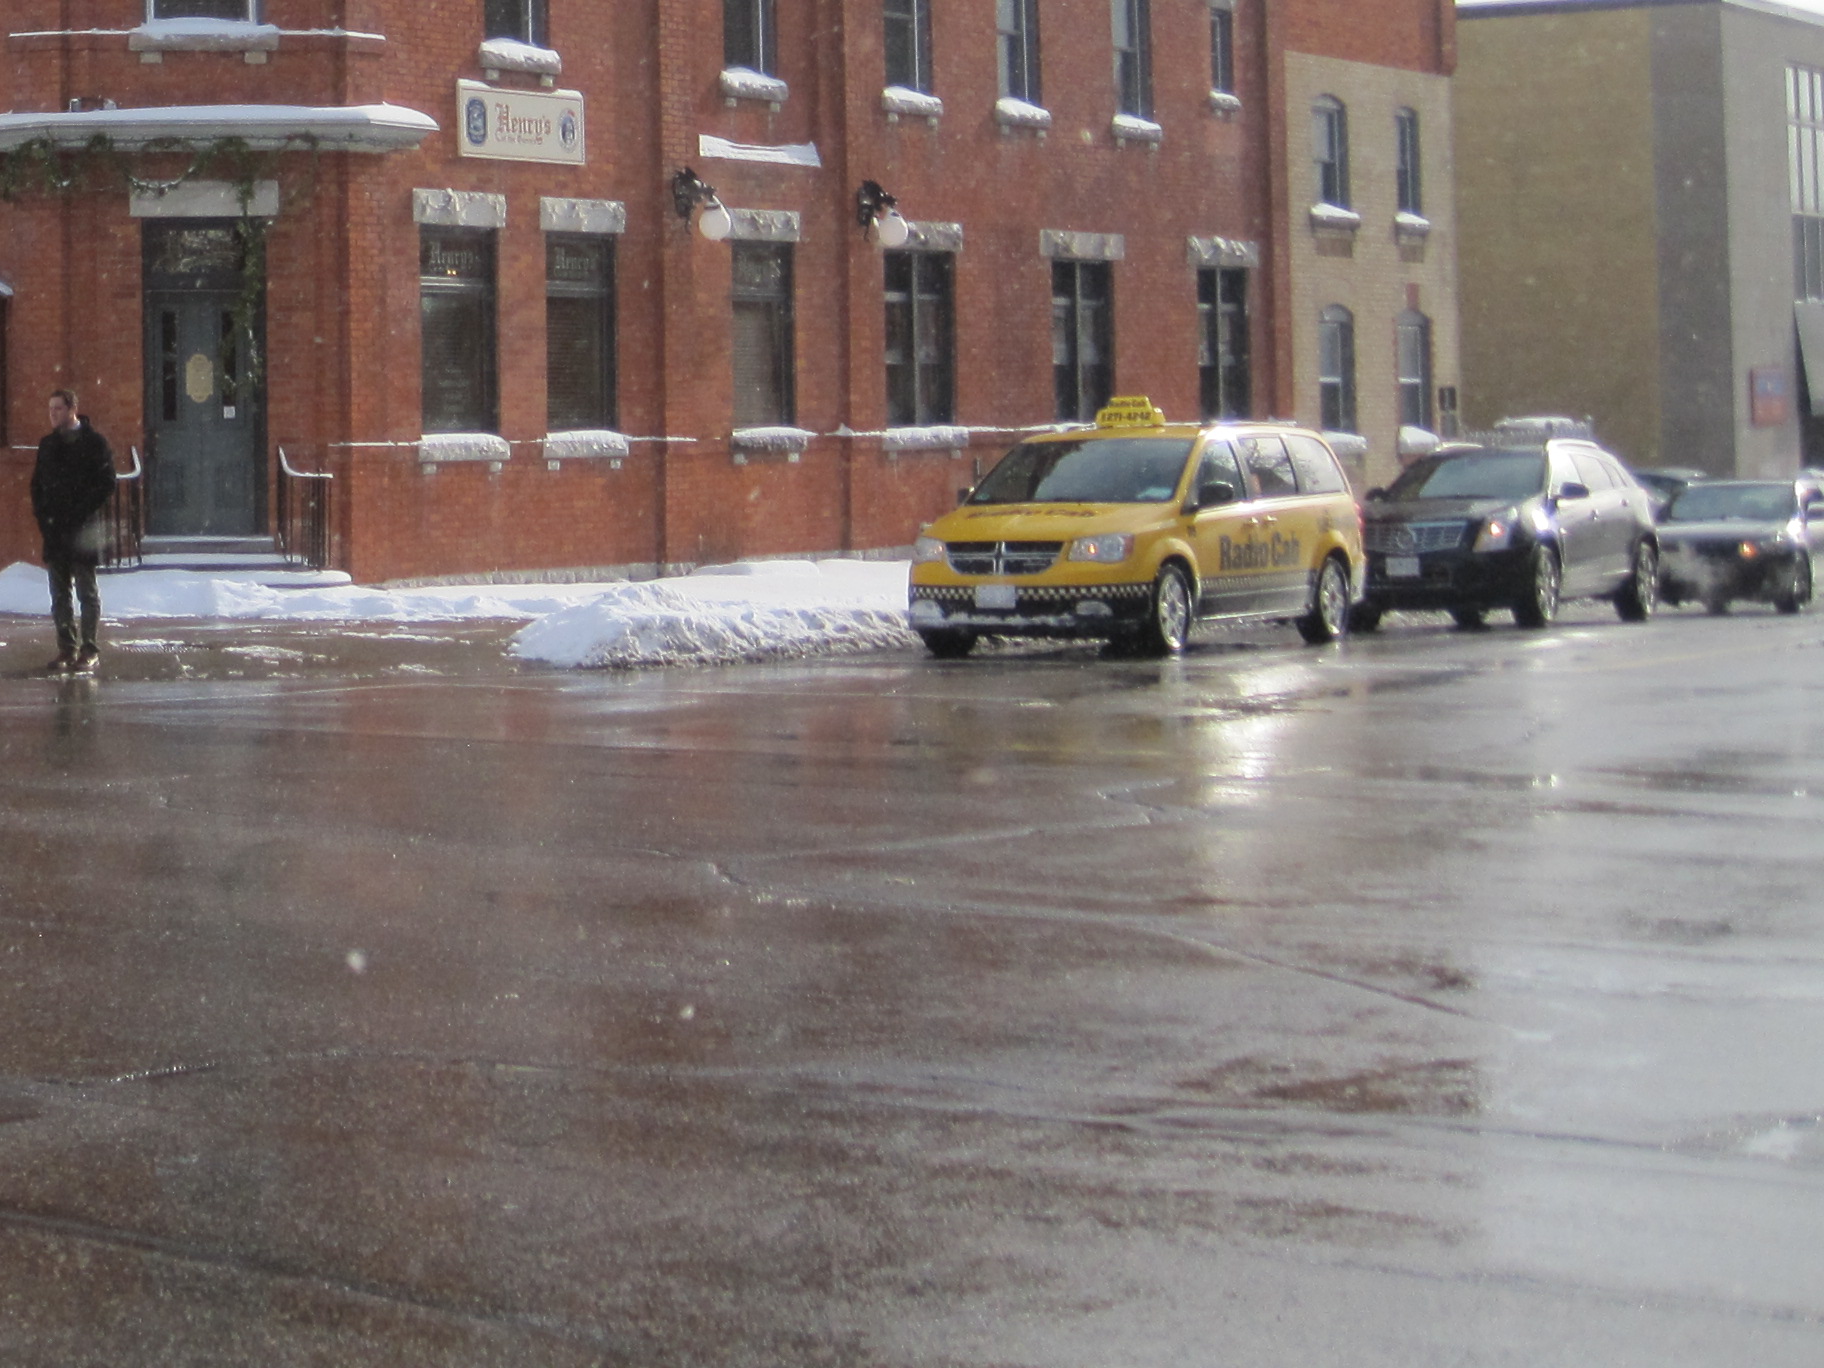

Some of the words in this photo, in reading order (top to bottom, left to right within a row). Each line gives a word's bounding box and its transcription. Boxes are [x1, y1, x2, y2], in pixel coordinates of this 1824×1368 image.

[495, 102, 551, 136] Henry's
[1219, 534, 1269, 571] Radio
[1271, 532, 1300, 566] Cab
